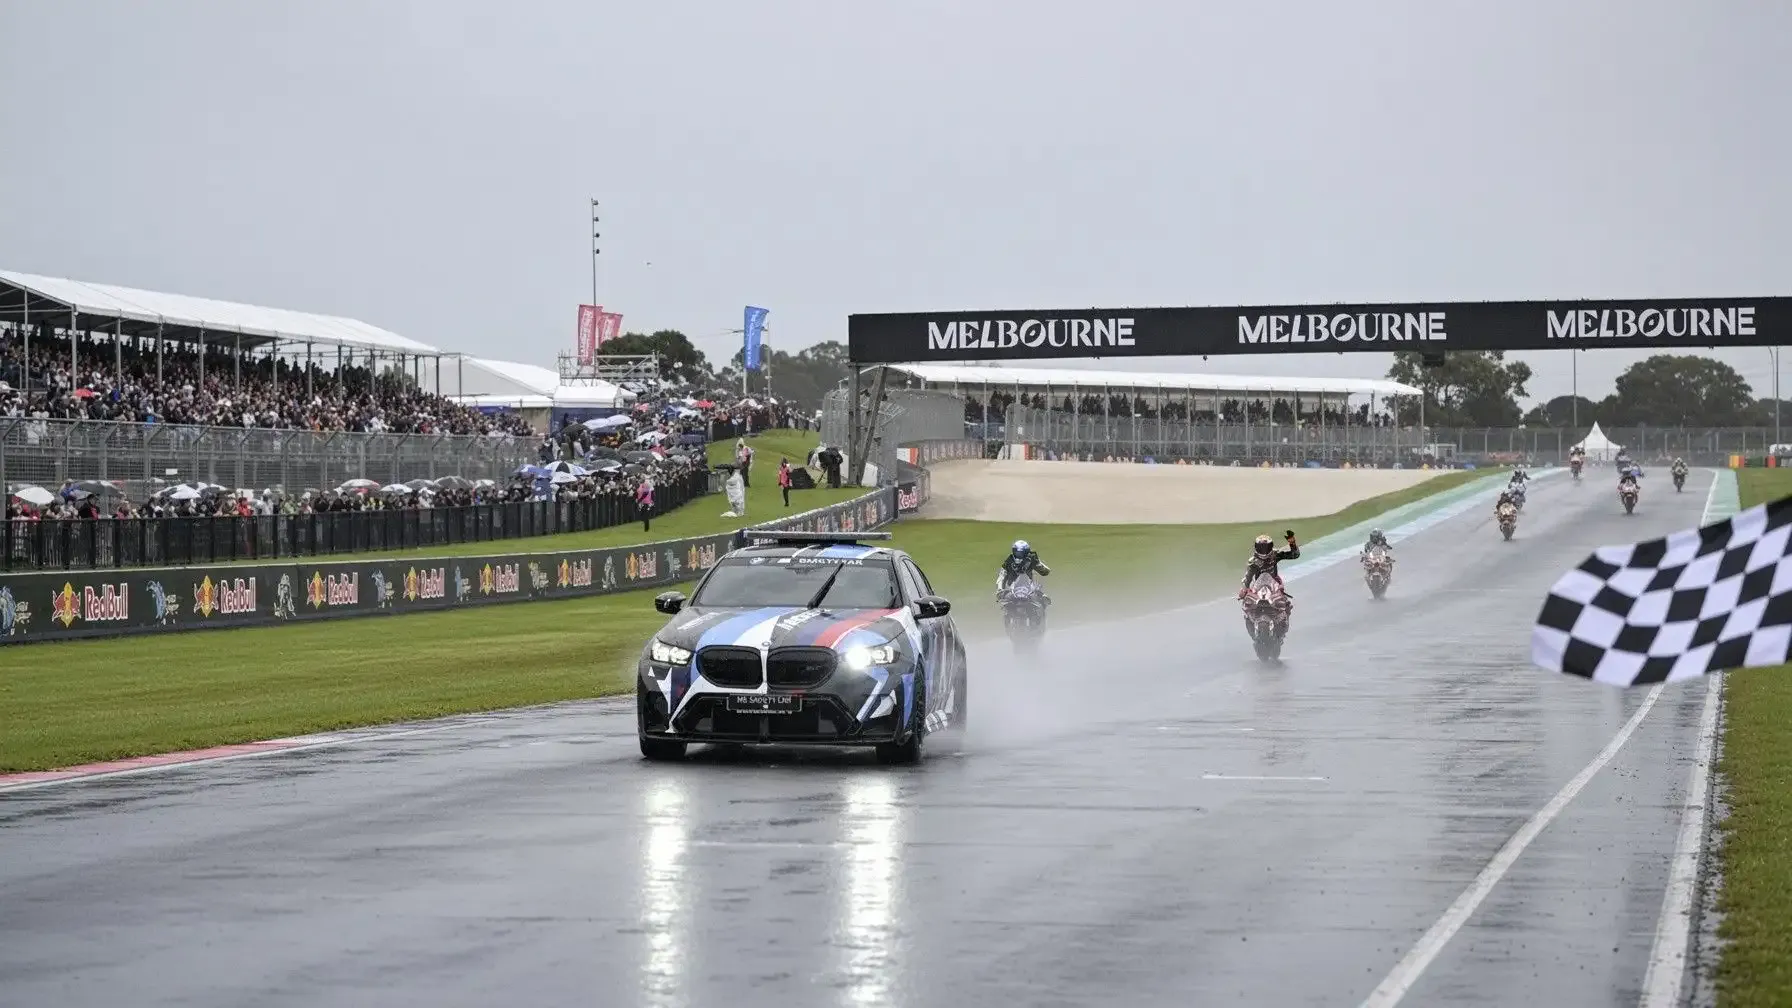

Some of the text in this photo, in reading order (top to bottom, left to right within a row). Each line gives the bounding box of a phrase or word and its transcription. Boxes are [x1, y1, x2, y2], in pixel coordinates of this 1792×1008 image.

[928, 318, 1135, 349] MELBOURNE
[1238, 312, 1447, 343] MELBOURNE
[1546, 307, 1756, 338] MELBOURNE
